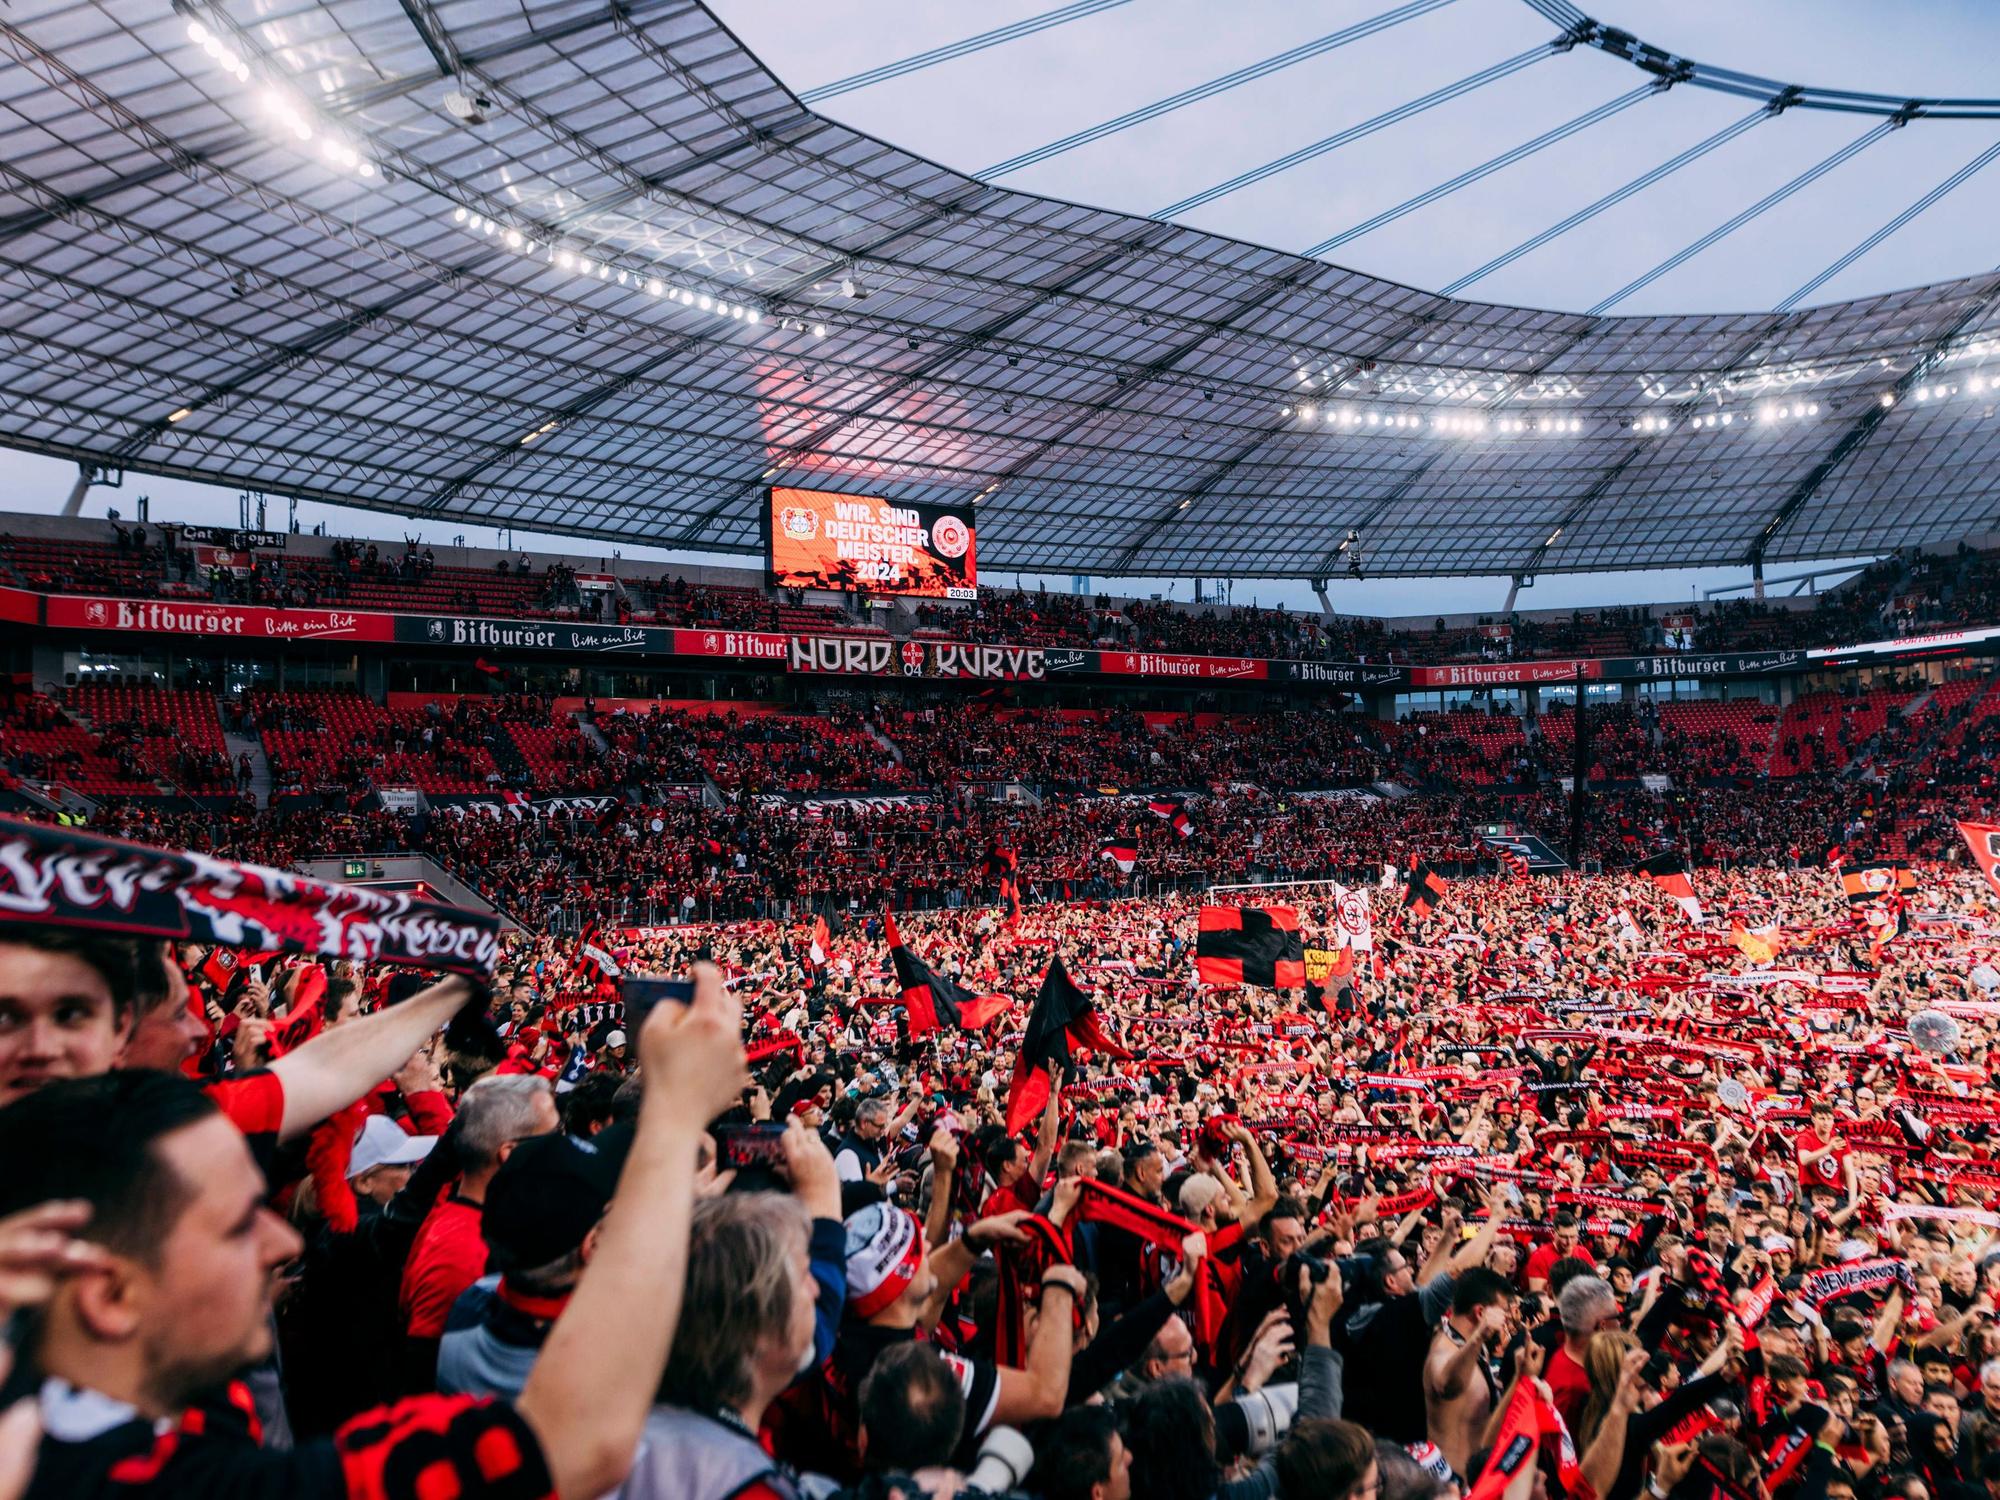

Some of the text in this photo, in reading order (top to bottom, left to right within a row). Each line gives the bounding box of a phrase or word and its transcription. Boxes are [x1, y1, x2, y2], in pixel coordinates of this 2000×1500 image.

[834, 502, 919, 527] WIR. SIND
[825, 520, 929, 547] DEUTSCHER
[837, 541, 919, 563] MEISTER.
[857, 562, 900, 581] 2024
[950, 589, 974, 599] 20:03
[115, 602, 357, 634] Bitburger Bitte ein Bit
[452, 619, 556, 647] Bitburger
[571, 632, 600, 647] Bitte
[602, 633, 623, 645] ein
[624, 629, 646, 642] Bit
[791, 638, 892, 672] NORD
[936, 645, 1045, 679] KURVE
[1054, 656, 1069, 664] ein
[1069, 651, 1085, 663] Bit
[1140, 655, 1255, 676] Bitburger Bitte ein Bit
[1652, 651, 1798, 676] Bitburger Bitte ein Bit
[904, 662, 922, 677] 04
[1301, 663, 1355, 682] Bitburger
[1450, 665, 1522, 684] Bitburger
[1532, 667, 1554, 682] Bitte
